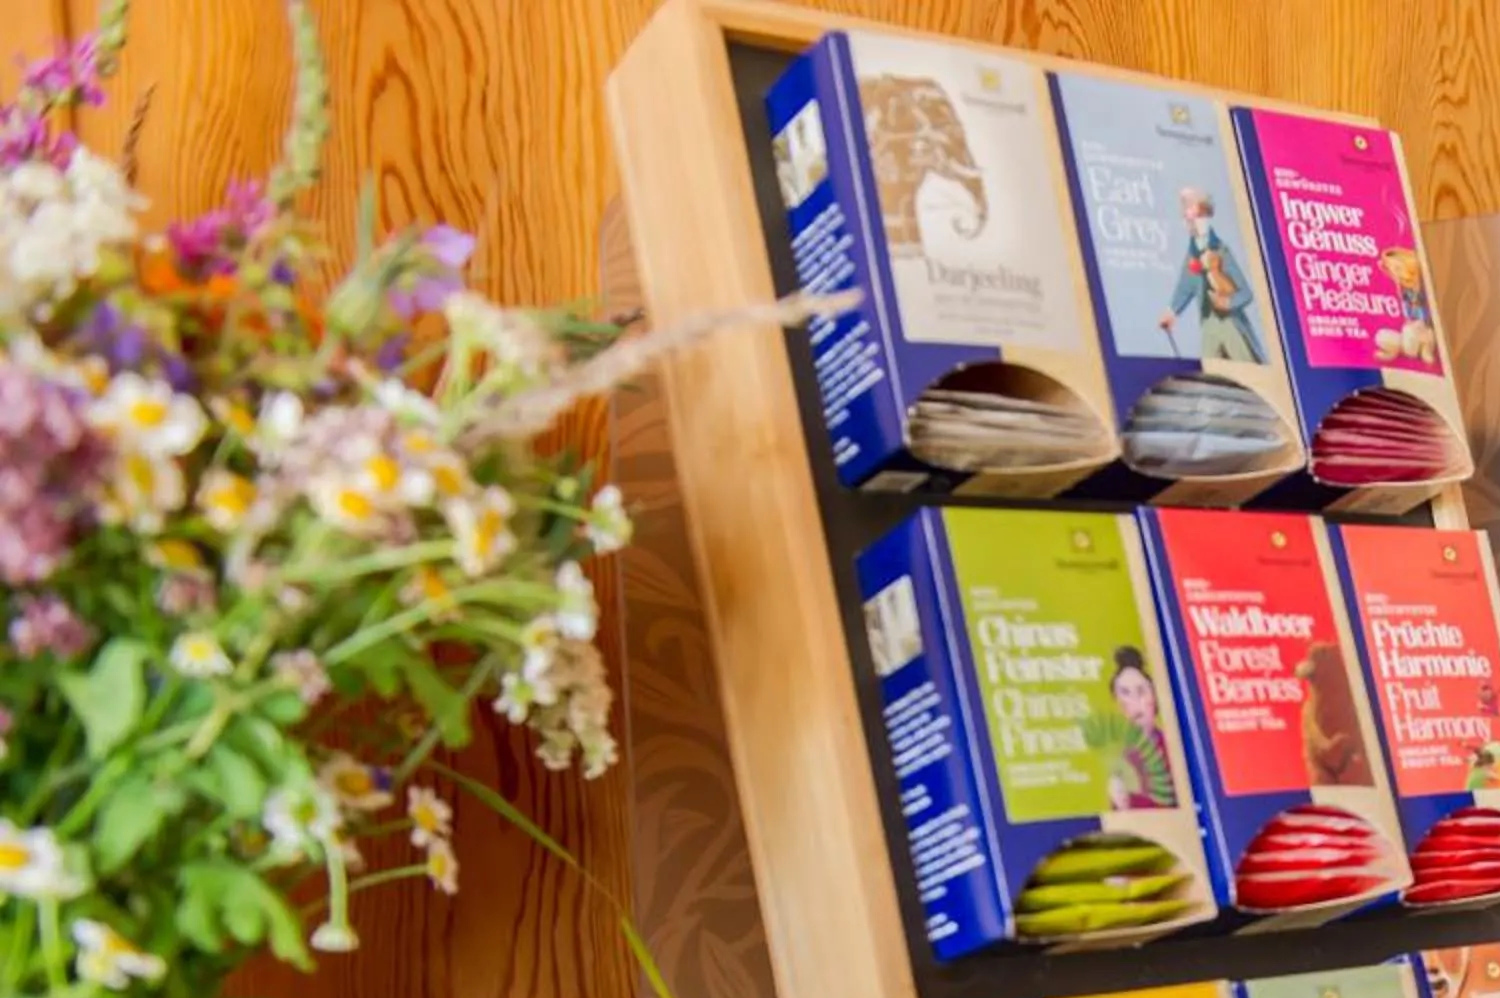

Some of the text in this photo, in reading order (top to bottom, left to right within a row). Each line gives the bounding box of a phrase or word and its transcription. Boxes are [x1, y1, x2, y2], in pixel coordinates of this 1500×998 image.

[1088, 166, 1154, 208] Earl
[1098, 204, 1168, 251] Grey
[1280, 191, 1364, 230] Ingwer
[1288, 221, 1379, 258] Genuss
[924, 257, 1045, 302] Darjeeling
[1296, 252, 1372, 289] Ginger
[1302, 281, 1400, 318] Pleasure
[1189, 605, 1315, 639] Waldbeer
[1371, 618, 1464, 648] Früchte
[1199, 641, 1283, 673] Forest
[1378, 648, 1492, 679] Harmonie
[1207, 671, 1303, 705] Berries
[1386, 680, 1442, 712] Fruit
[1391, 710, 1492, 742] Harmony
